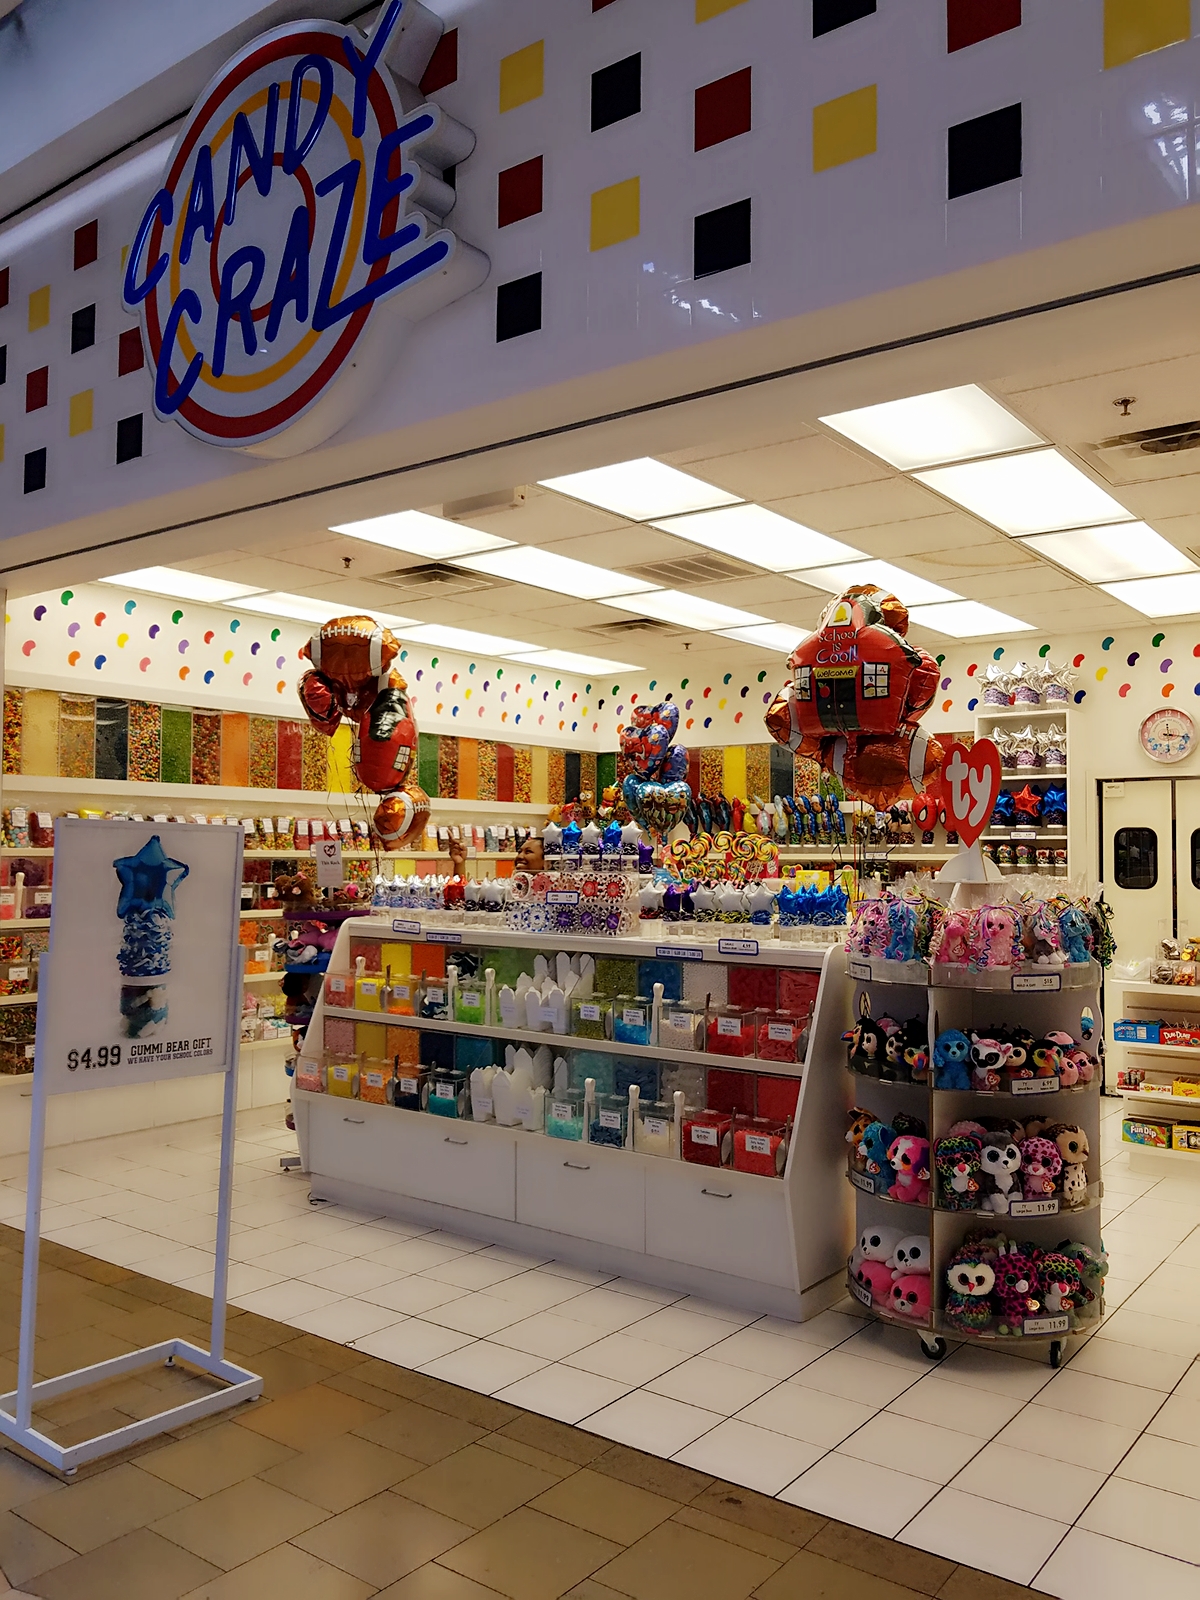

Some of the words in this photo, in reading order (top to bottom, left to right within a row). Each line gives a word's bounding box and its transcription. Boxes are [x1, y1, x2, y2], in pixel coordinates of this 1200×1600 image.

[124, 0, 404, 305] CANDY
[155, 114, 449, 415] CRAZE
[818, 628, 858, 642] School
[816, 644, 859, 664] Cool!
[816, 669, 854, 678] welcome
[945, 751, 992, 827] ty
[130, 1042, 163, 1057] GUMMI
[166, 1039, 189, 1053] BEAR
[192, 1037, 211, 1050] GIFT
[67, 1044, 121, 1072] $4.99
[127, 1057, 138, 1065] WE
[139, 1055, 154, 1064] HAVE
[155, 1053, 171, 1062] YOUR
[172, 1050, 192, 1060] SCHOOL
[193, 1048, 213, 1058] COLORS
[1130, 1125, 1143, 1134] Fun
[1144, 1127, 1157, 1138] Dip
[1037, 1203, 1055, 1211] 11.99
[1049, 1319, 1066, 1329] 11.99
